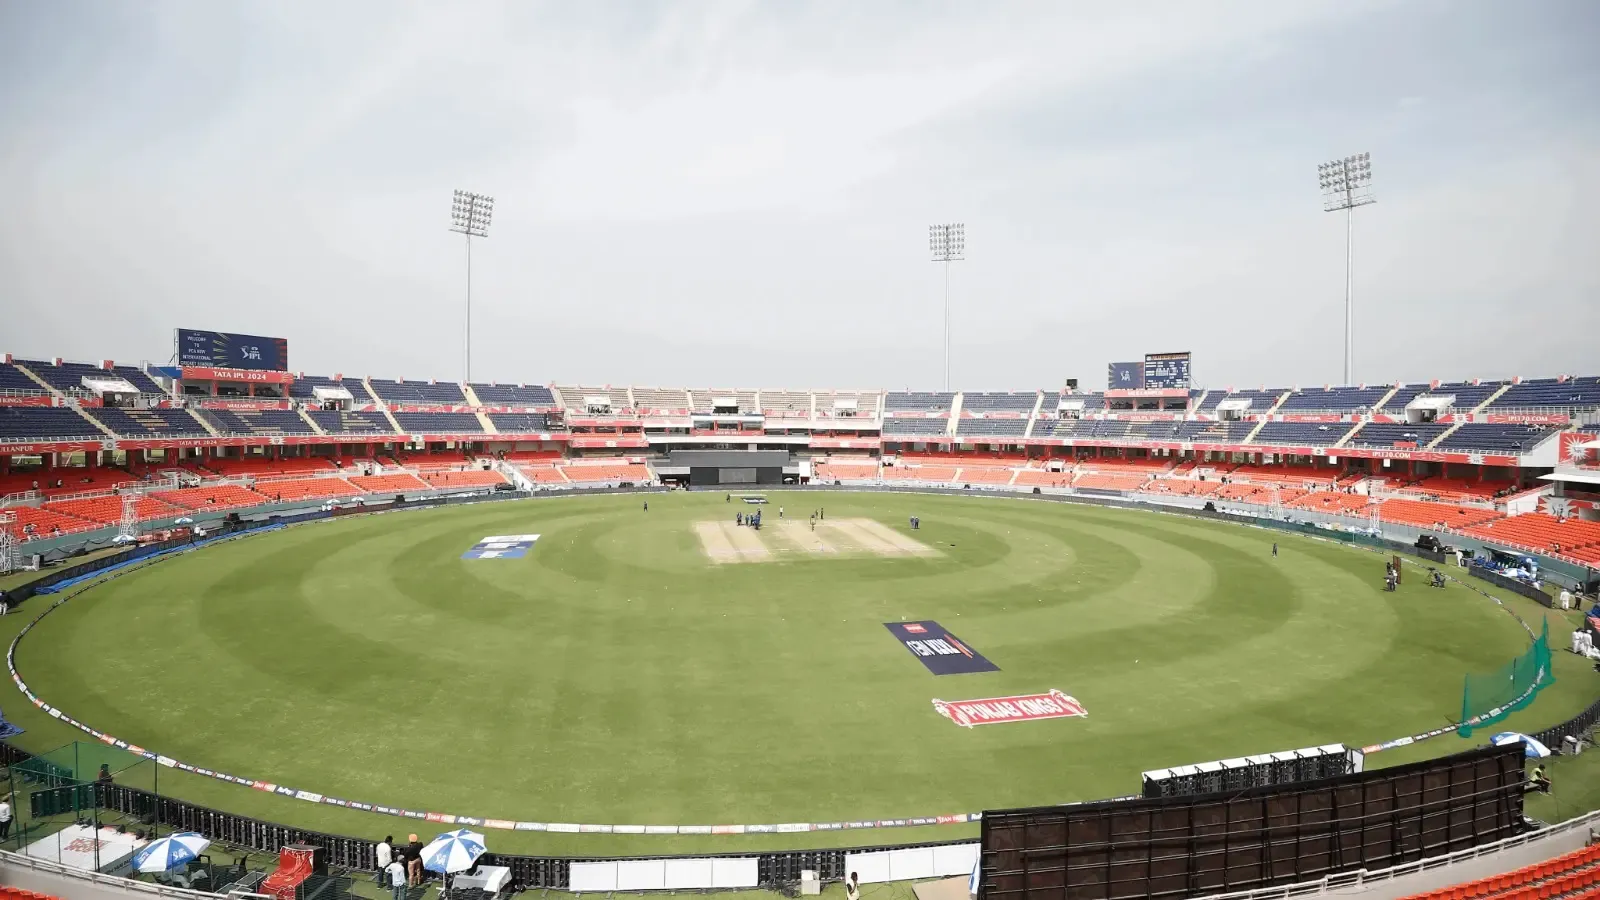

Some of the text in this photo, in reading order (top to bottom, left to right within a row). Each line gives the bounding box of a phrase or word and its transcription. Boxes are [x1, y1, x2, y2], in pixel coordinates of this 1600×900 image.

[213, 370, 232, 378] TATA
[1371, 451, 1411, 459] IPLT20.COM
[959, 697, 1064, 721] PUNJAB KINGS
